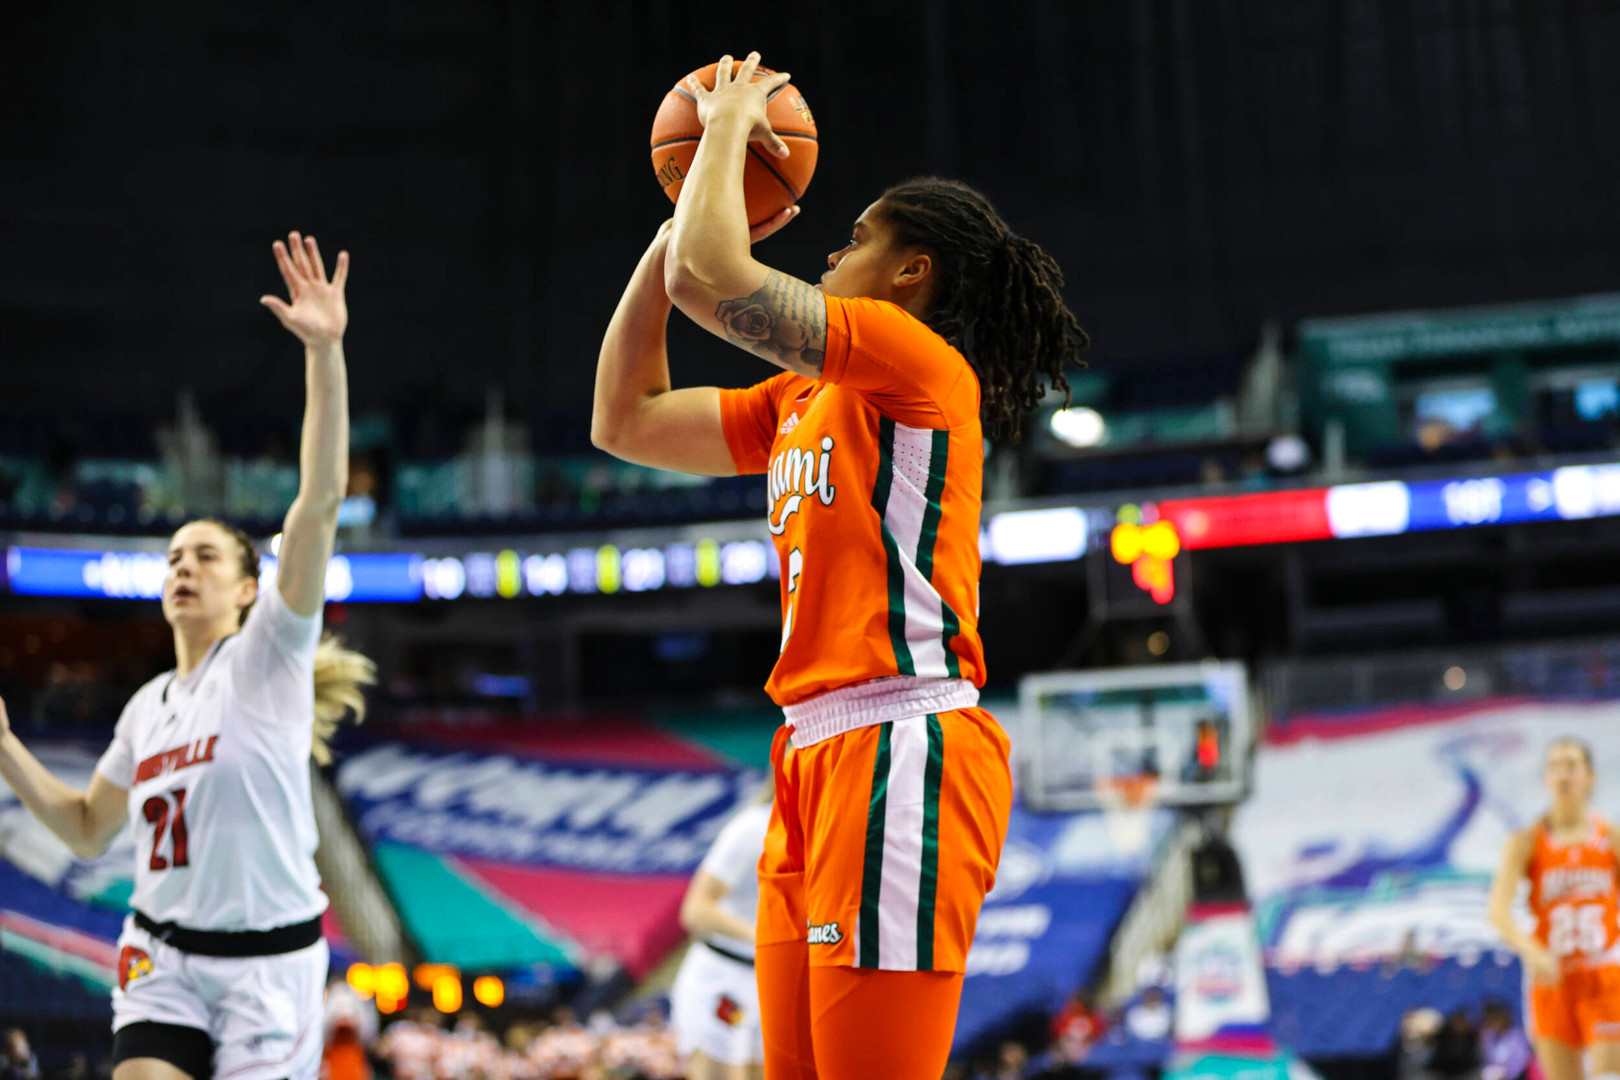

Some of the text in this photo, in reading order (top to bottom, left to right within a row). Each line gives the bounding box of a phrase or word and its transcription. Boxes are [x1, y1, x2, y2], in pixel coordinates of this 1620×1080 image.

[656, 156, 684, 187] NG
[767, 436, 836, 534] iami
[142, 788, 189, 871] 21
[807, 921, 843, 945] anes
